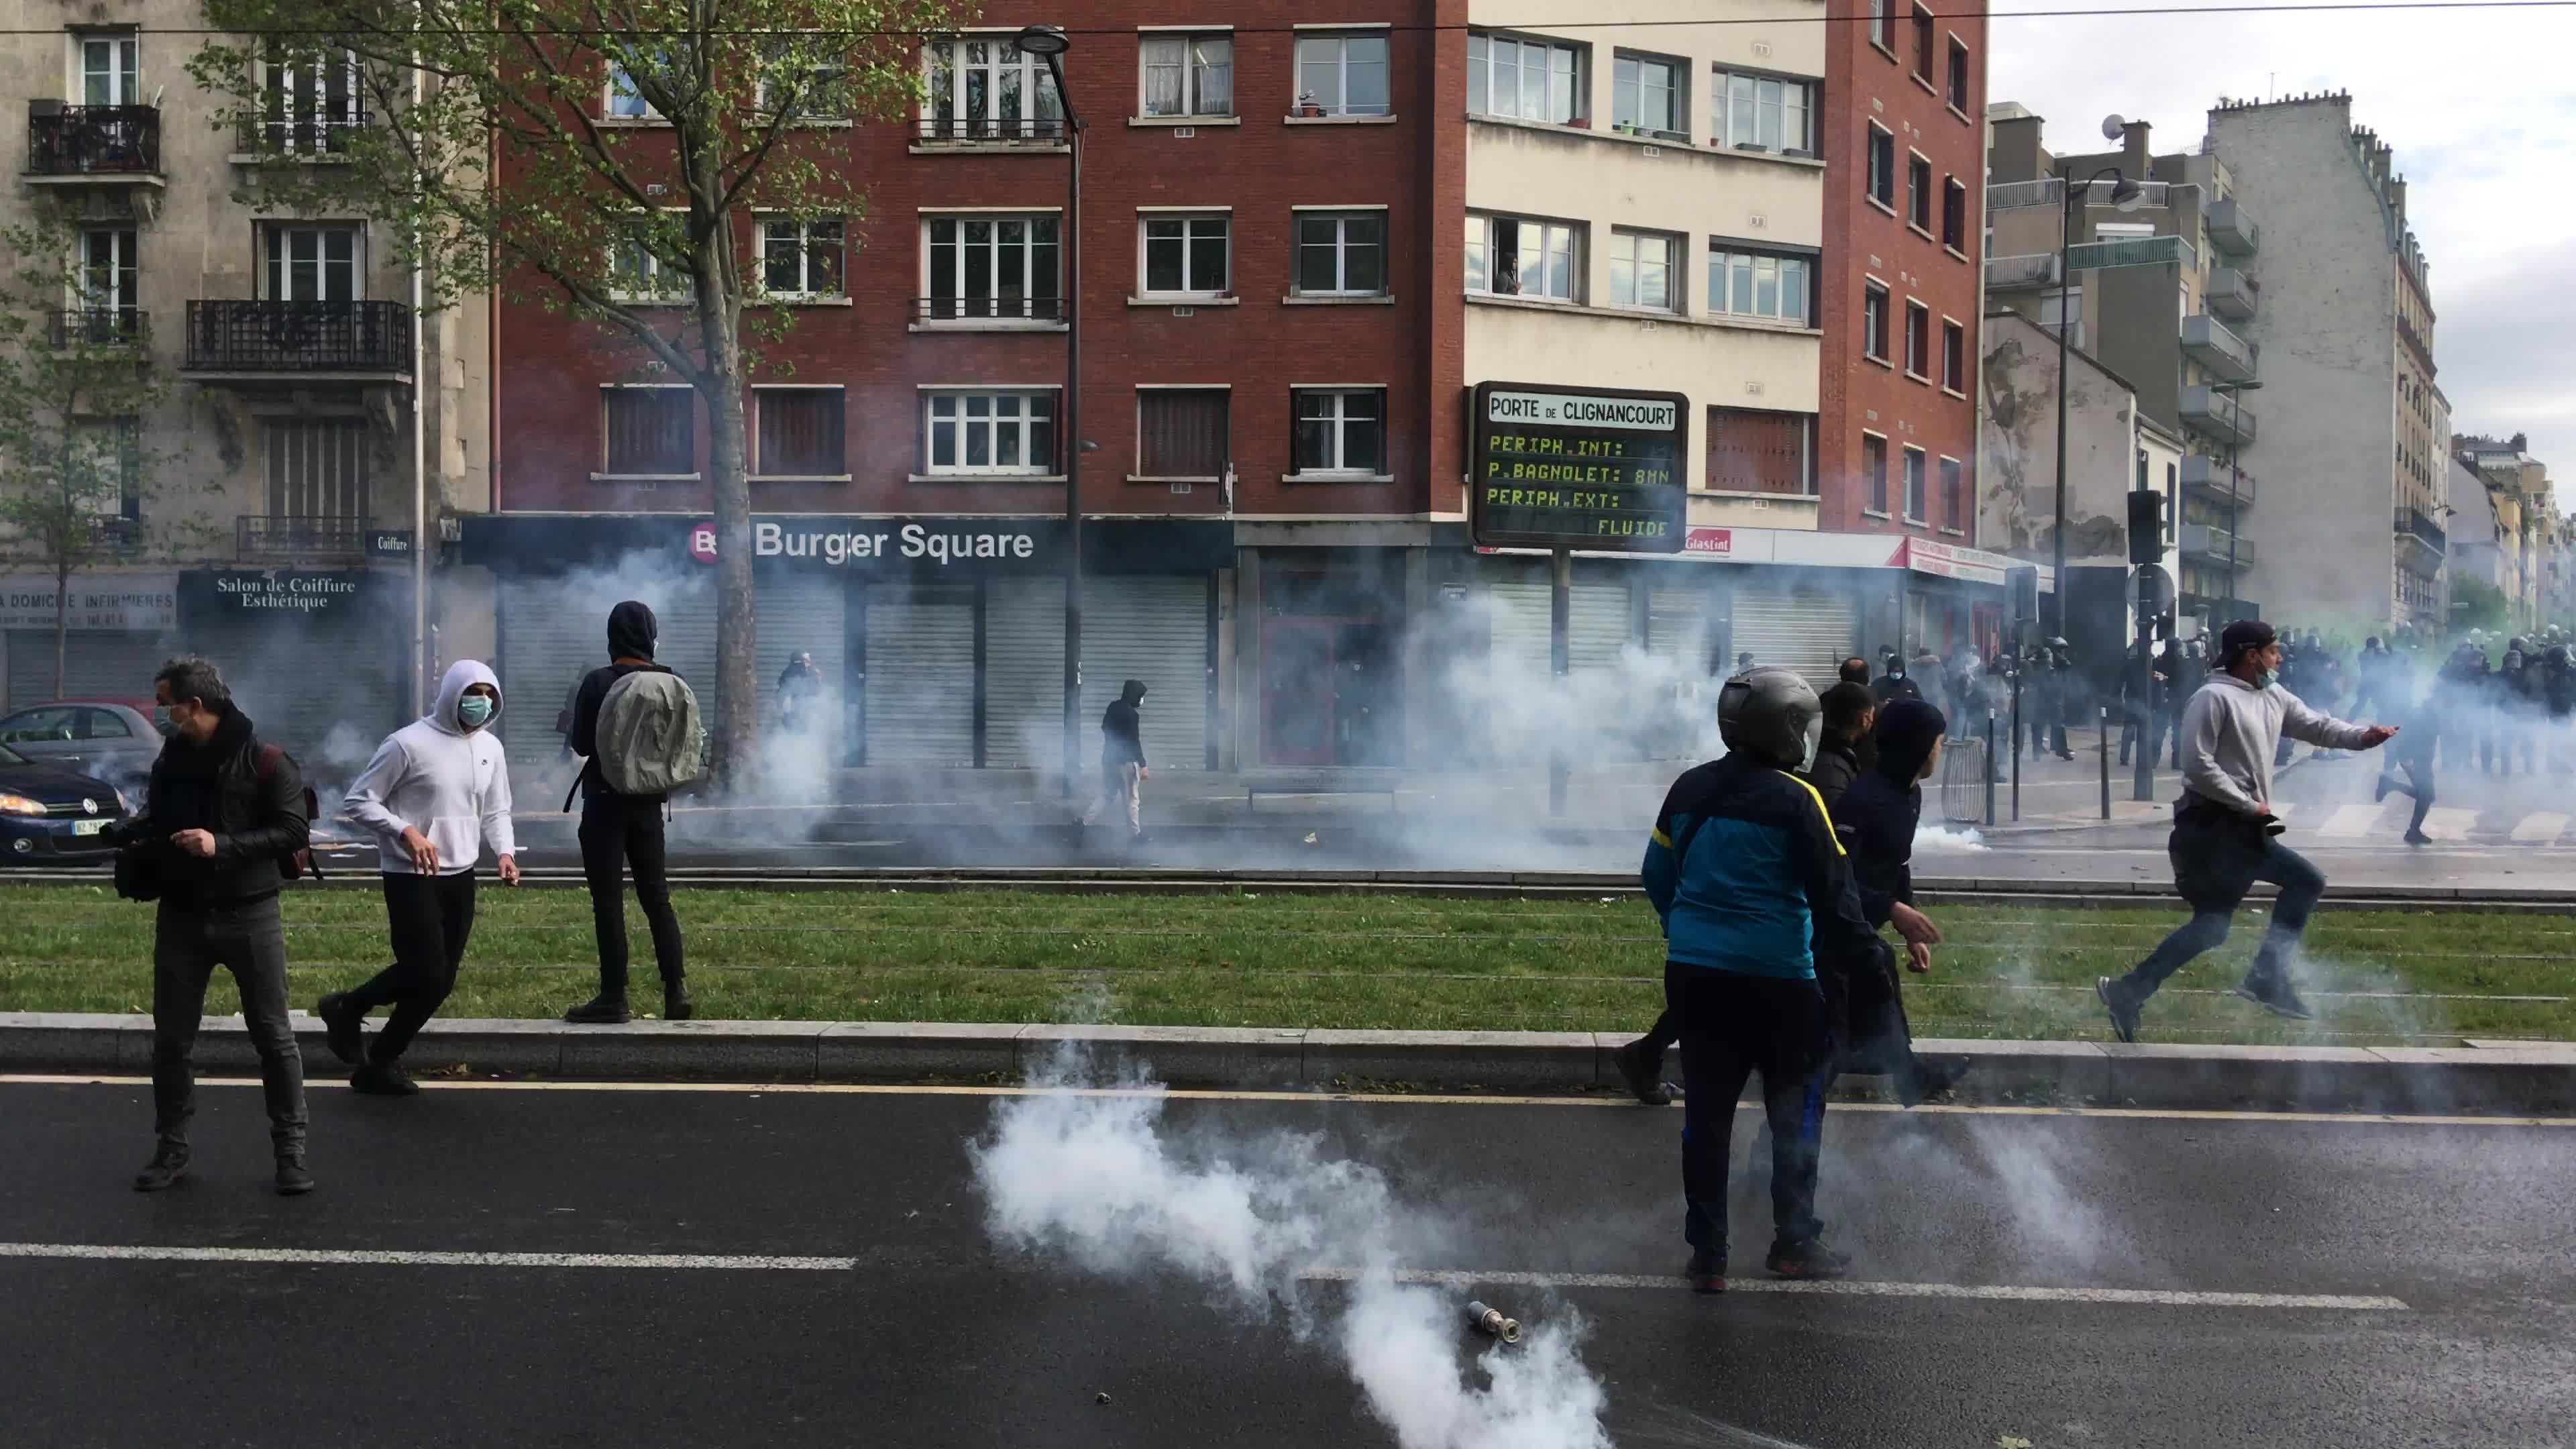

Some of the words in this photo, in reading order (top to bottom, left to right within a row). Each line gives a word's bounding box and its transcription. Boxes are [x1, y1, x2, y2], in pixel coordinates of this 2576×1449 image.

[1491, 397, 1540, 417] PORTE
[1546, 408, 1556, 418] DE
[1564, 402, 1674, 425] CLIGNANCOURT
[1487, 462, 1621, 482] P.BAGNOLET:
[1598, 519, 1669, 537] FLUIDE
[378, 536, 407, 551] Coiffure
[756, 523, 888, 566] Burger
[900, 523, 1034, 565] Square
[1686, 537, 1729, 551] Glastint
[217, 578, 261, 592] Salon
[266, 577, 285, 592] de
[289, 578, 356, 592] Coiffure
[241, 593, 328, 612] Esthétique
